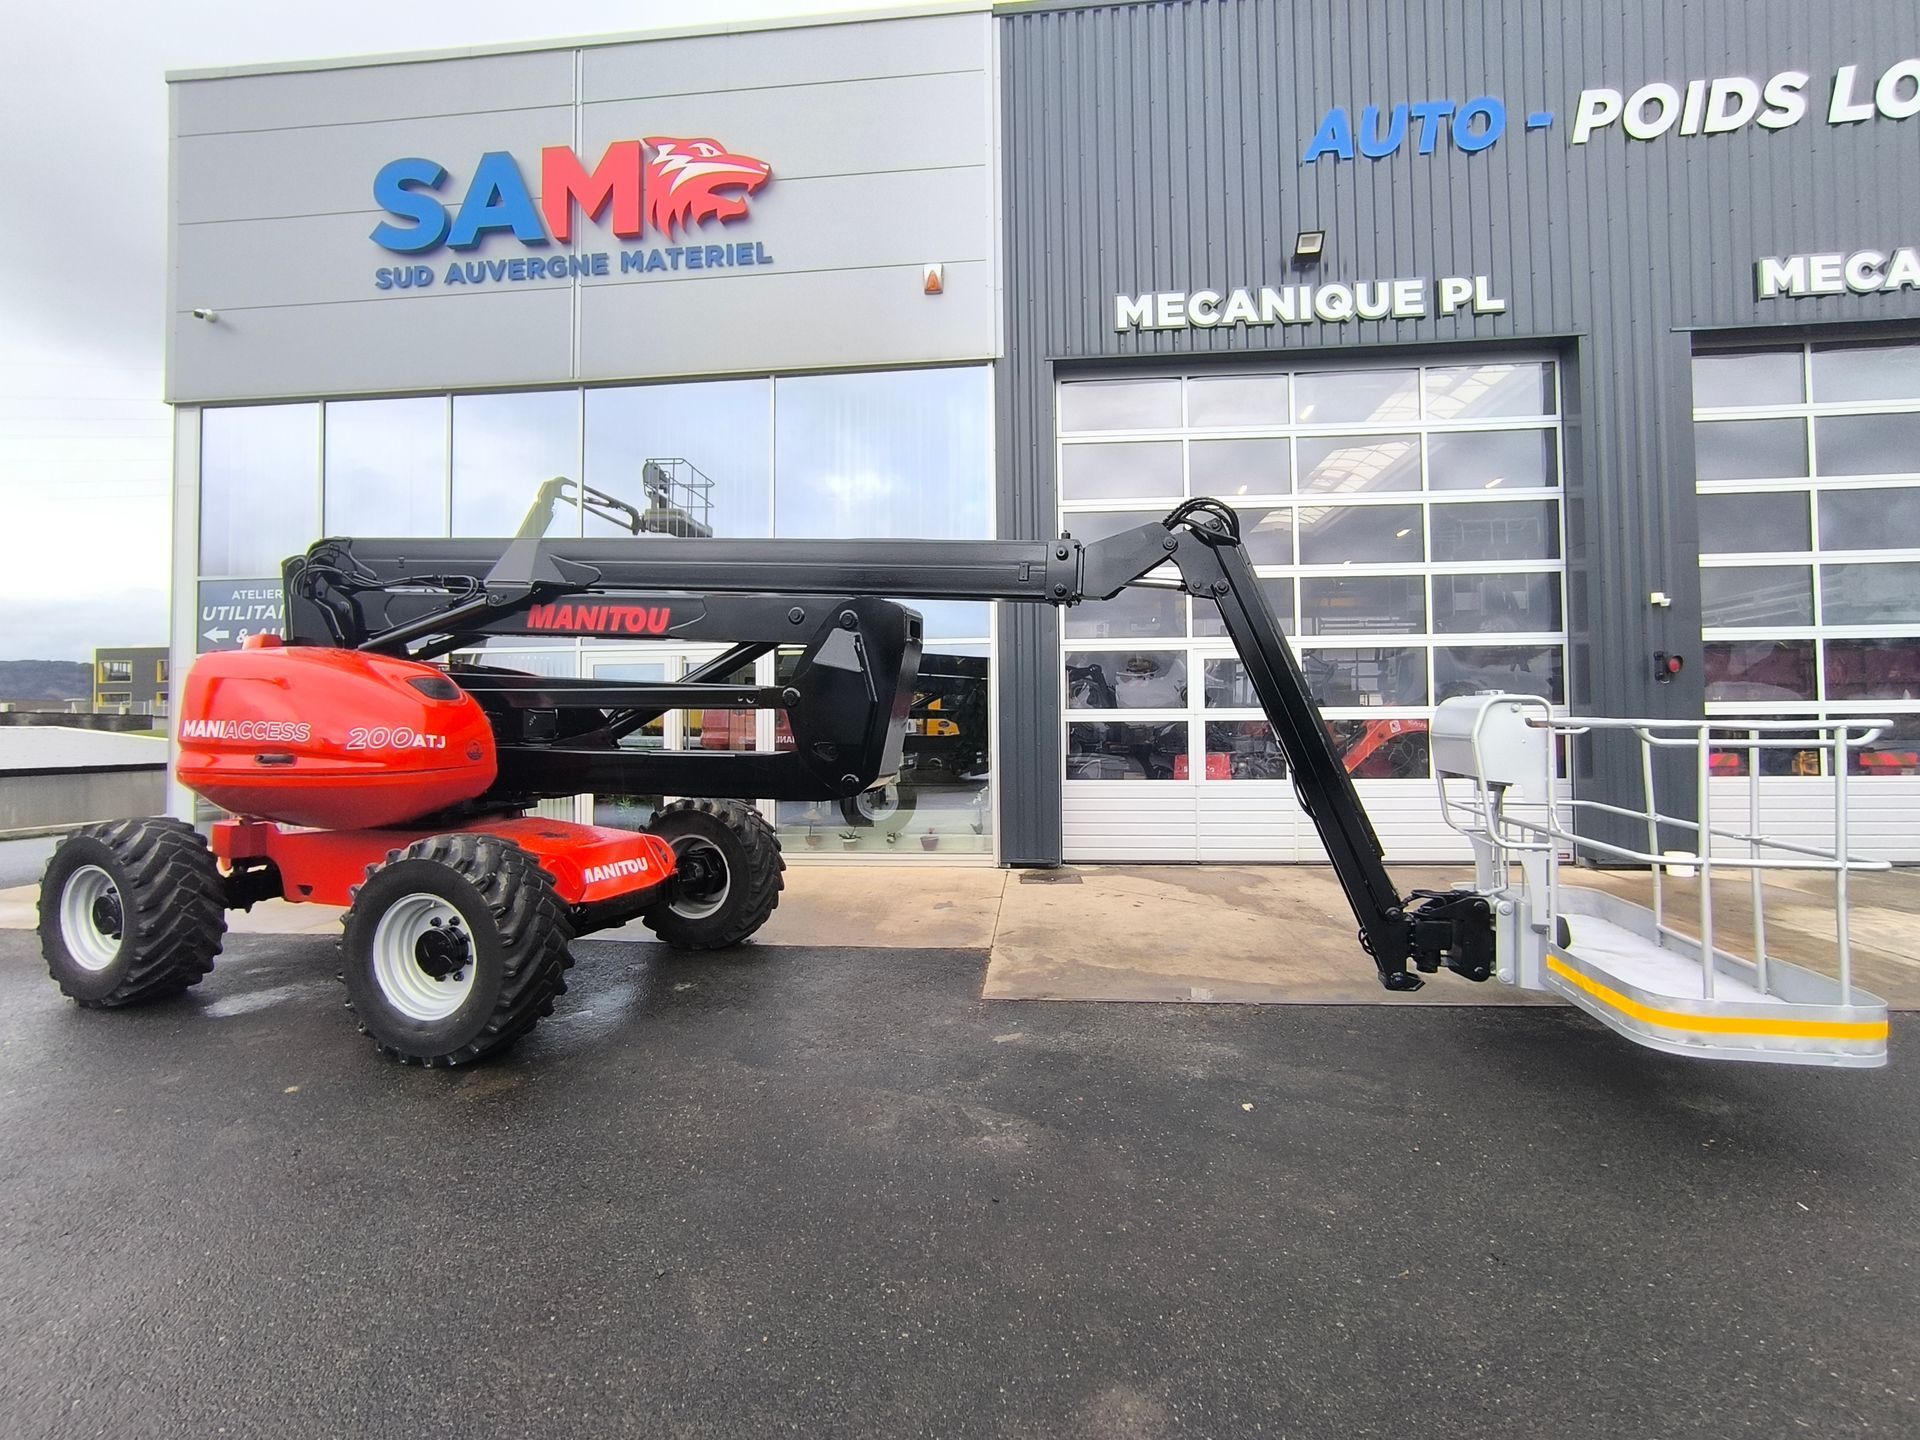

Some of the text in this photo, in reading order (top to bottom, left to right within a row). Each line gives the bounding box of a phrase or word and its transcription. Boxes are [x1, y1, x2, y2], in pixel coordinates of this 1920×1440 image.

[1303, 97, 1505, 163] AUTO
[1572, 71, 1809, 144] POIDS
[1828, 58, 1920, 124] LO
[369, 139, 643, 254] SAM
[375, 242, 773, 289] SUD AUVERGNE MATERIEL
[1758, 248, 1920, 300] MECA
[1115, 275, 1506, 330] MECANIQUE PL
[527, 604, 671, 633] MANITOU
[183, 720, 311, 742] MANIACCESS
